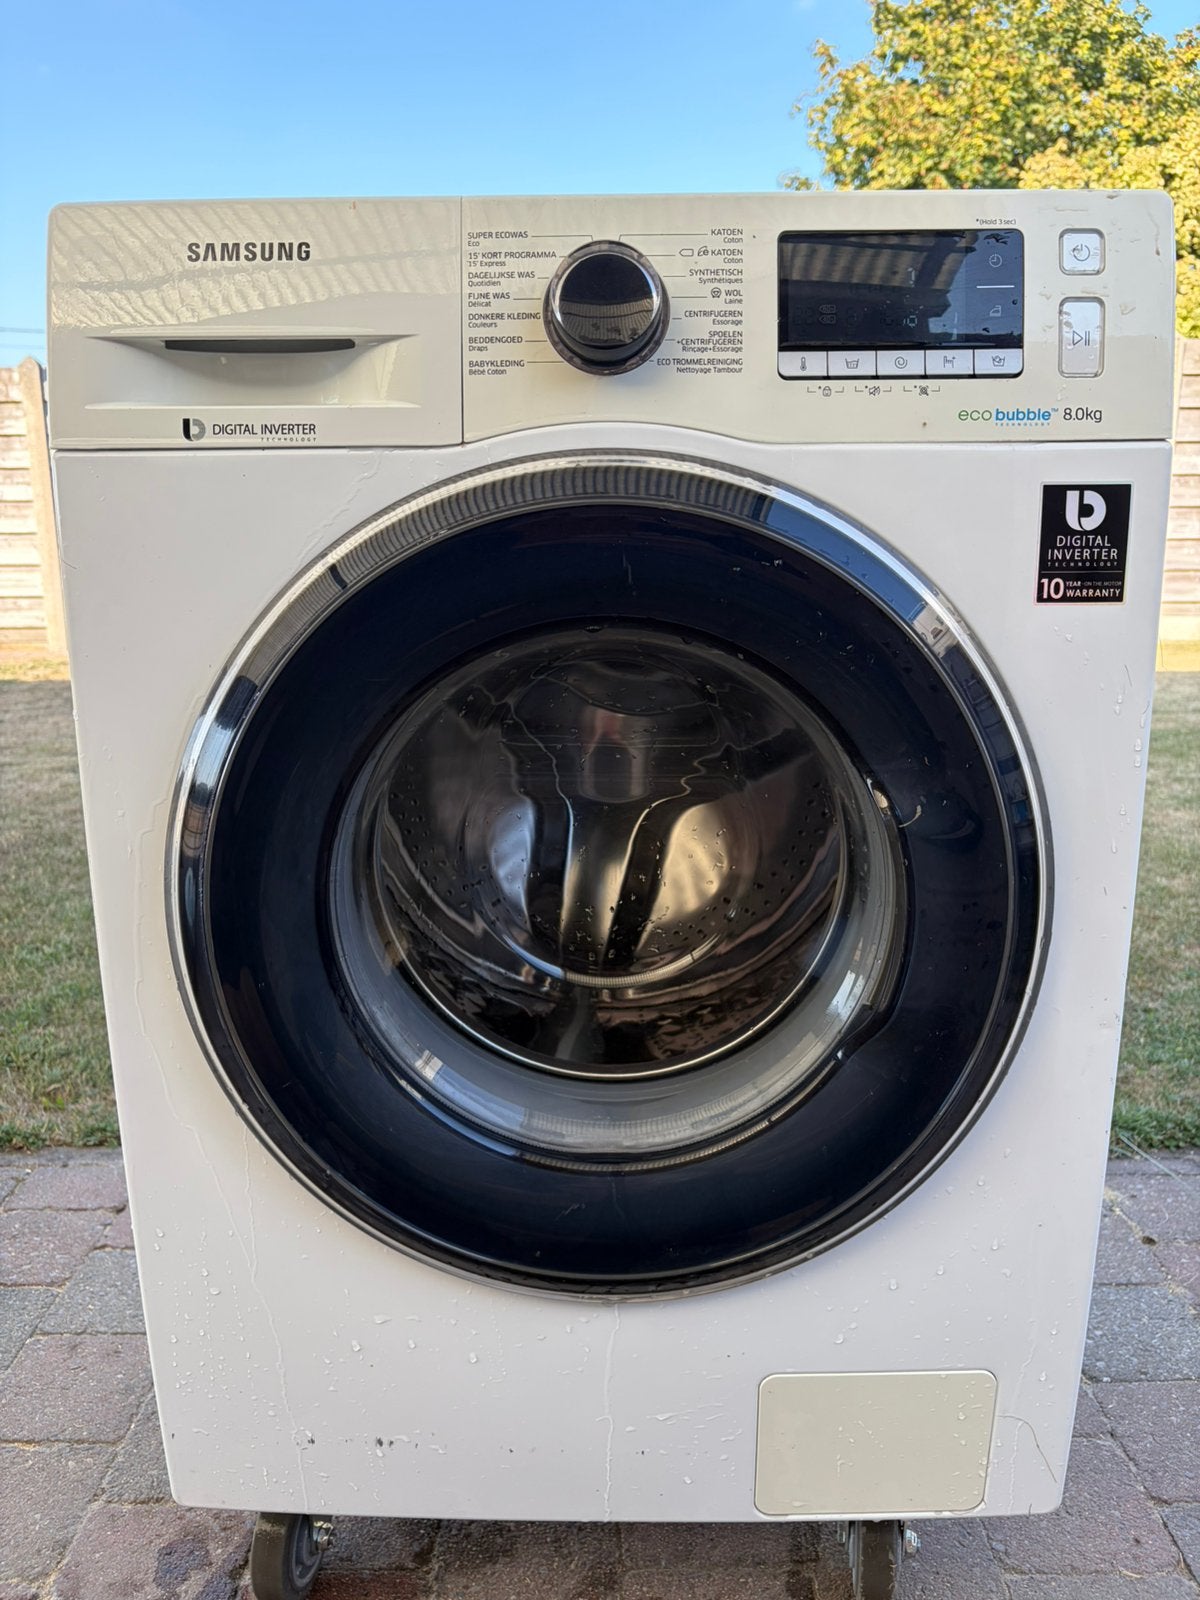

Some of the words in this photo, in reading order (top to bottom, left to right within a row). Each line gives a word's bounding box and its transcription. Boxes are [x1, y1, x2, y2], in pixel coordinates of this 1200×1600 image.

[187, 242, 311, 262] SAMSUNG
[468, 336, 523, 344] BEDDENGOED
[958, 410, 992, 421] eco
[1063, 407, 1102, 423] 8.0kg
[212, 424, 258, 435] DIGITAL
[260, 424, 316, 434] INVERTER
[1056, 535, 1111, 546] DIGITAL
[1048, 548, 1118, 560] INVERTER
[1040, 578, 1064, 600] 10
[1066, 588, 1120, 598] WARRANTY
